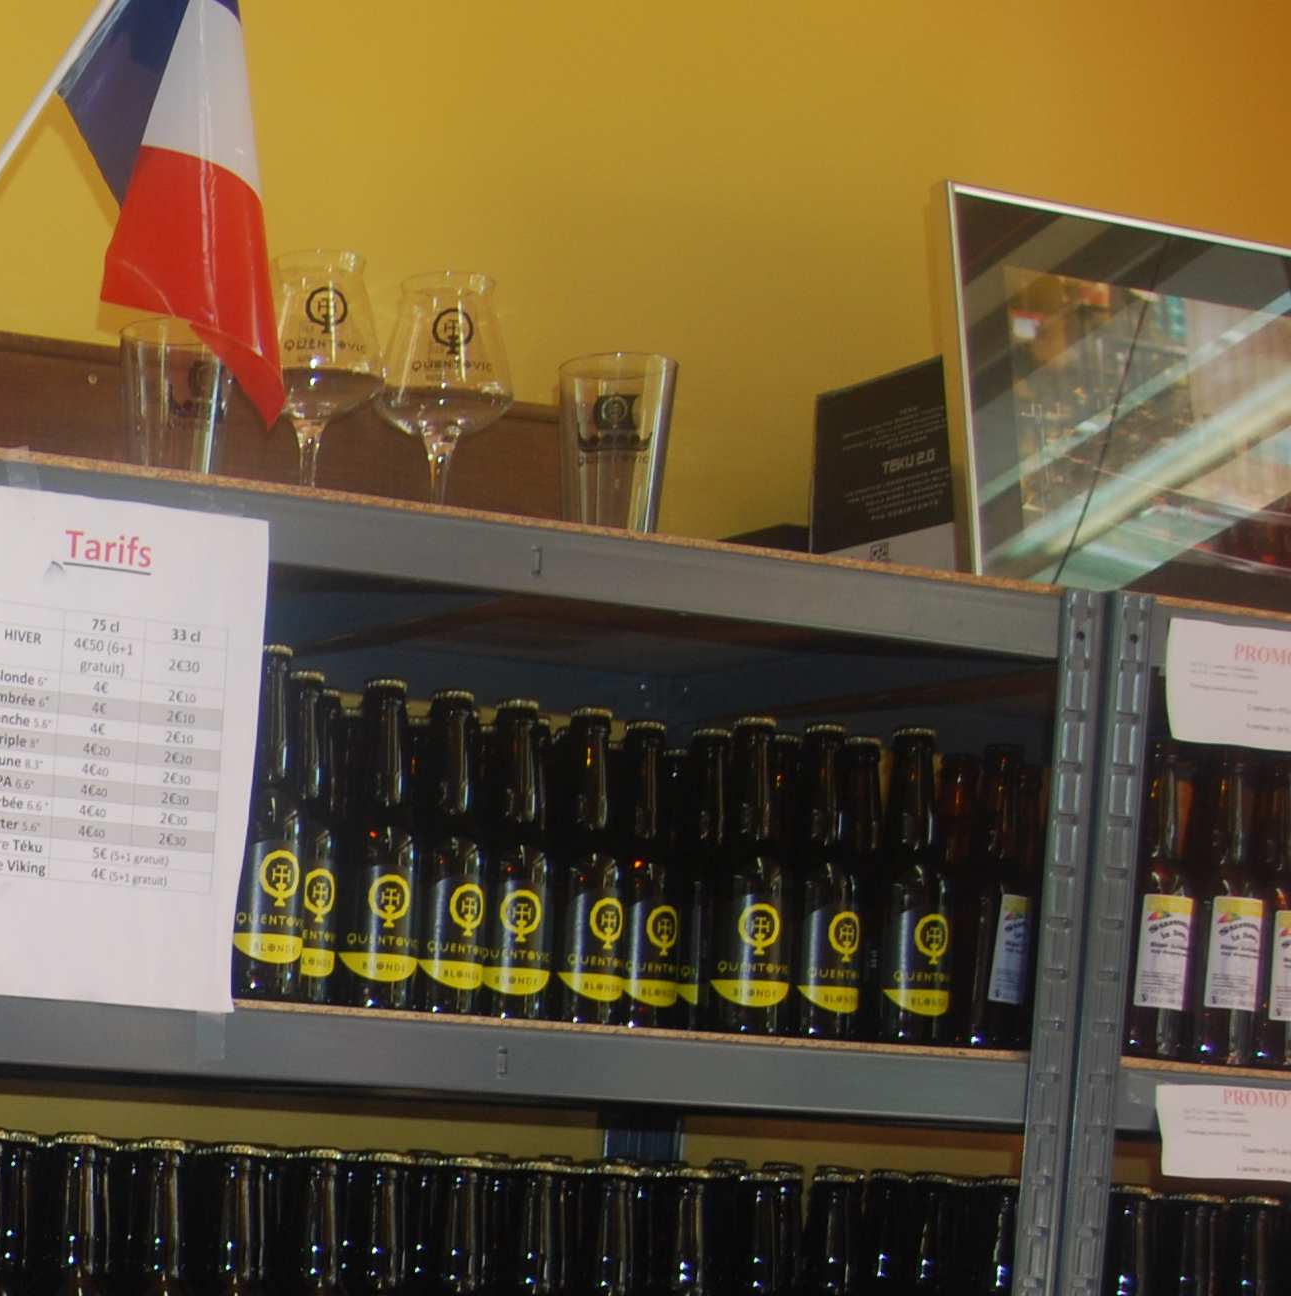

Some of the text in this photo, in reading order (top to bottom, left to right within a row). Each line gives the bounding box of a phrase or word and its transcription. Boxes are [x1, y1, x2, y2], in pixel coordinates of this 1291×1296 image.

[65, 530, 153, 568] Tarifs
[92, 618, 200, 643] 75 cl 33 cl
[4, 628, 133, 656] HIVER 4€50 (6+1
[80, 659, 200, 677] gratuit) 2€30
[93, 682, 108, 693] 4€
[168, 690, 197, 704] 2€10
[92, 703, 106, 714] 4€
[167, 711, 195, 724] 2€10
[90, 723, 105, 735] 4€
[165, 731, 194, 745] 2€10
[83, 742, 111, 757] 4€20
[164, 752, 192, 765] 2€20
[81, 763, 109, 777] 4€40
[162, 771, 191, 786] 2€30
[80, 784, 108, 798] 4€40
[161, 794, 190, 806] 2€30
[79, 805, 106, 818] 4€40
[160, 813, 187, 826] 2€30
[78, 826, 105, 839] 4€40
[159, 834, 186, 847] 2€30
[13, 839, 43, 853] Téku
[92, 847, 107, 859] 5€
[133, 853, 169, 867] gratuit)
[6, 860, 45, 876] Viking
[91, 869, 105, 880] 4€
[132, 873, 167, 887] gratuit)
